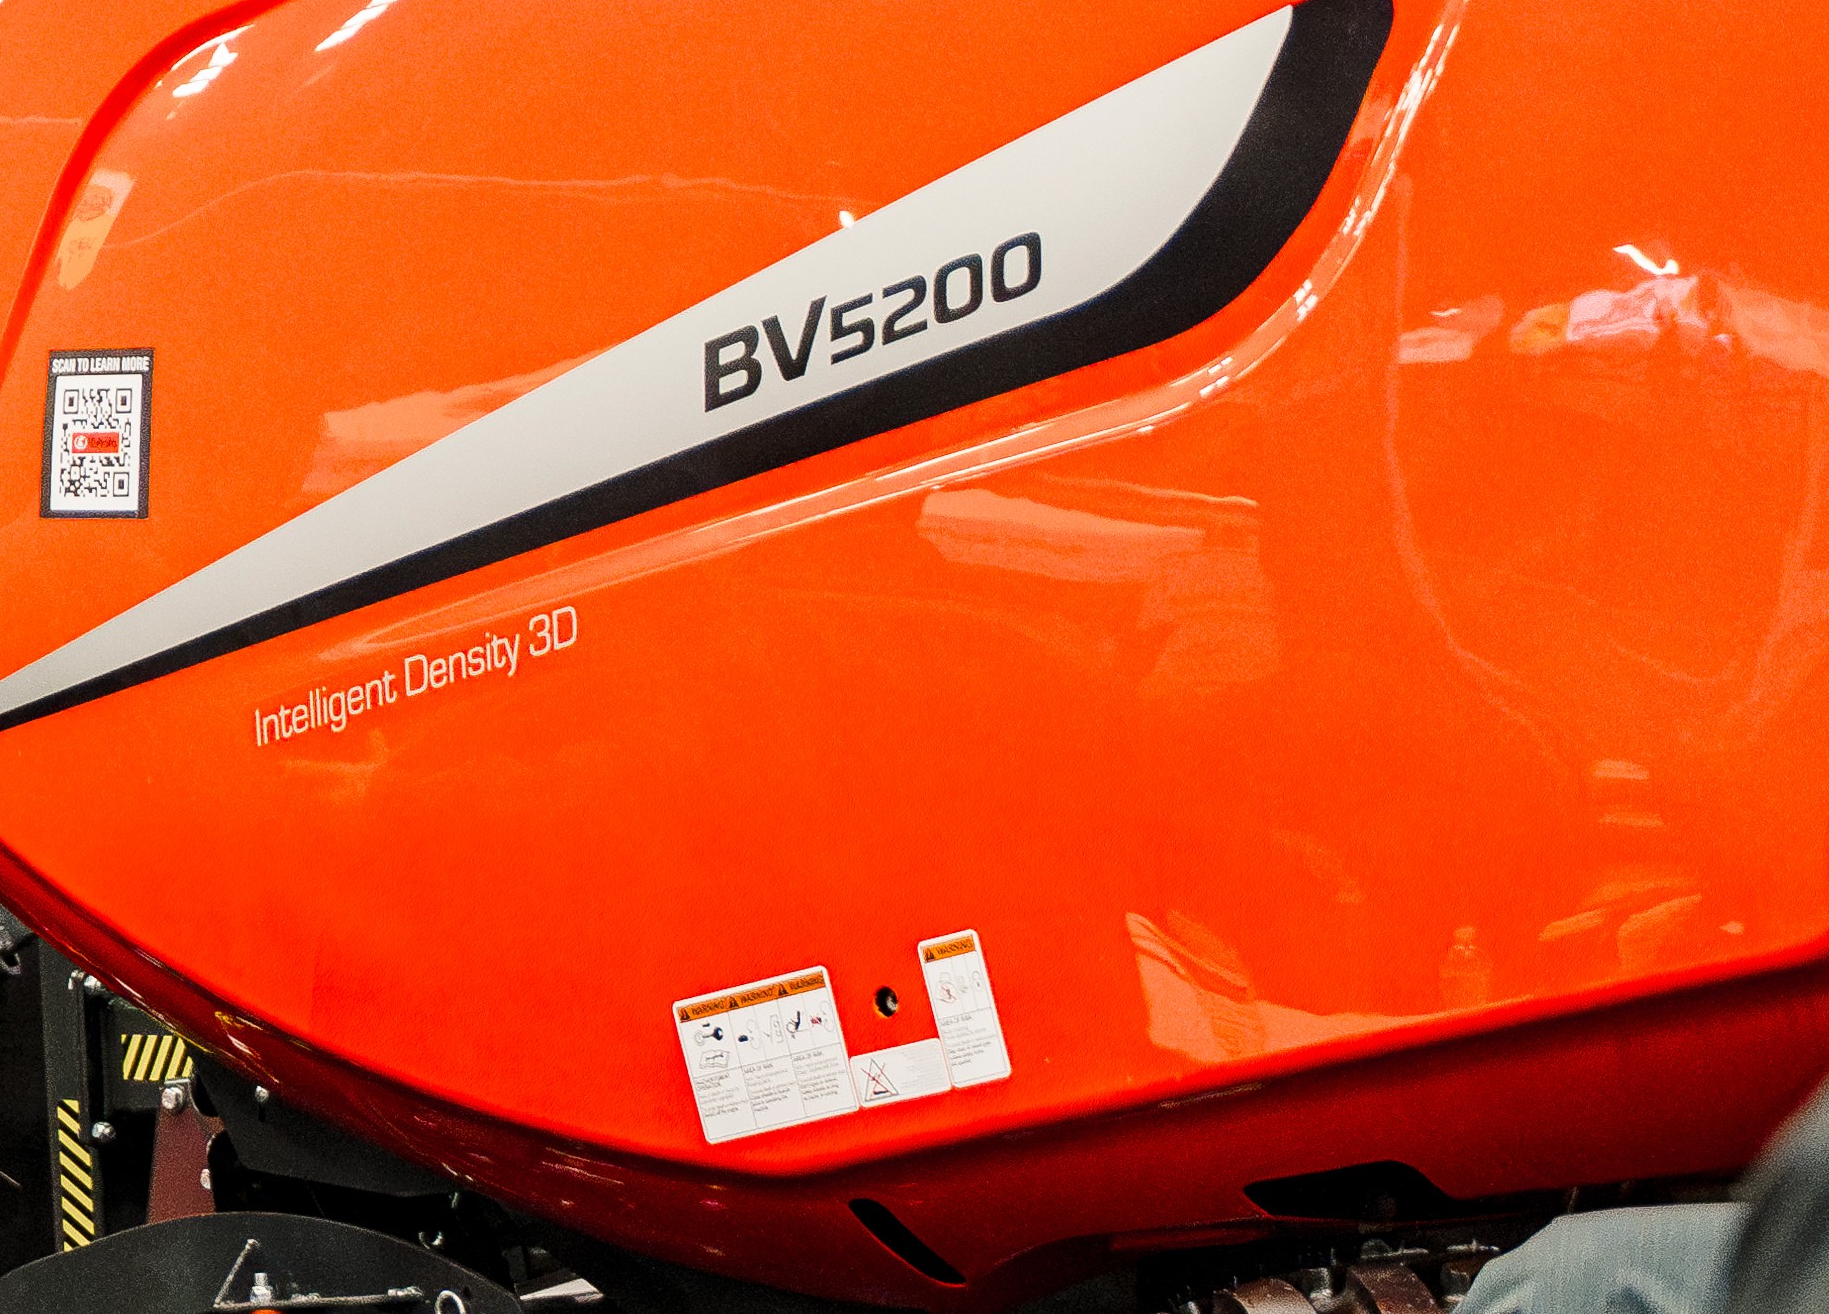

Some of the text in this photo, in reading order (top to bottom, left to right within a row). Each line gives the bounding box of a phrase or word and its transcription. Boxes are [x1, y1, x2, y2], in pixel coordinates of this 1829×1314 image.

[52, 355, 150, 373] SCAN TO LEARN MORE
[704, 231, 1042, 413] BV5200
[255, 605, 579, 748] Intelligent Density 3D
